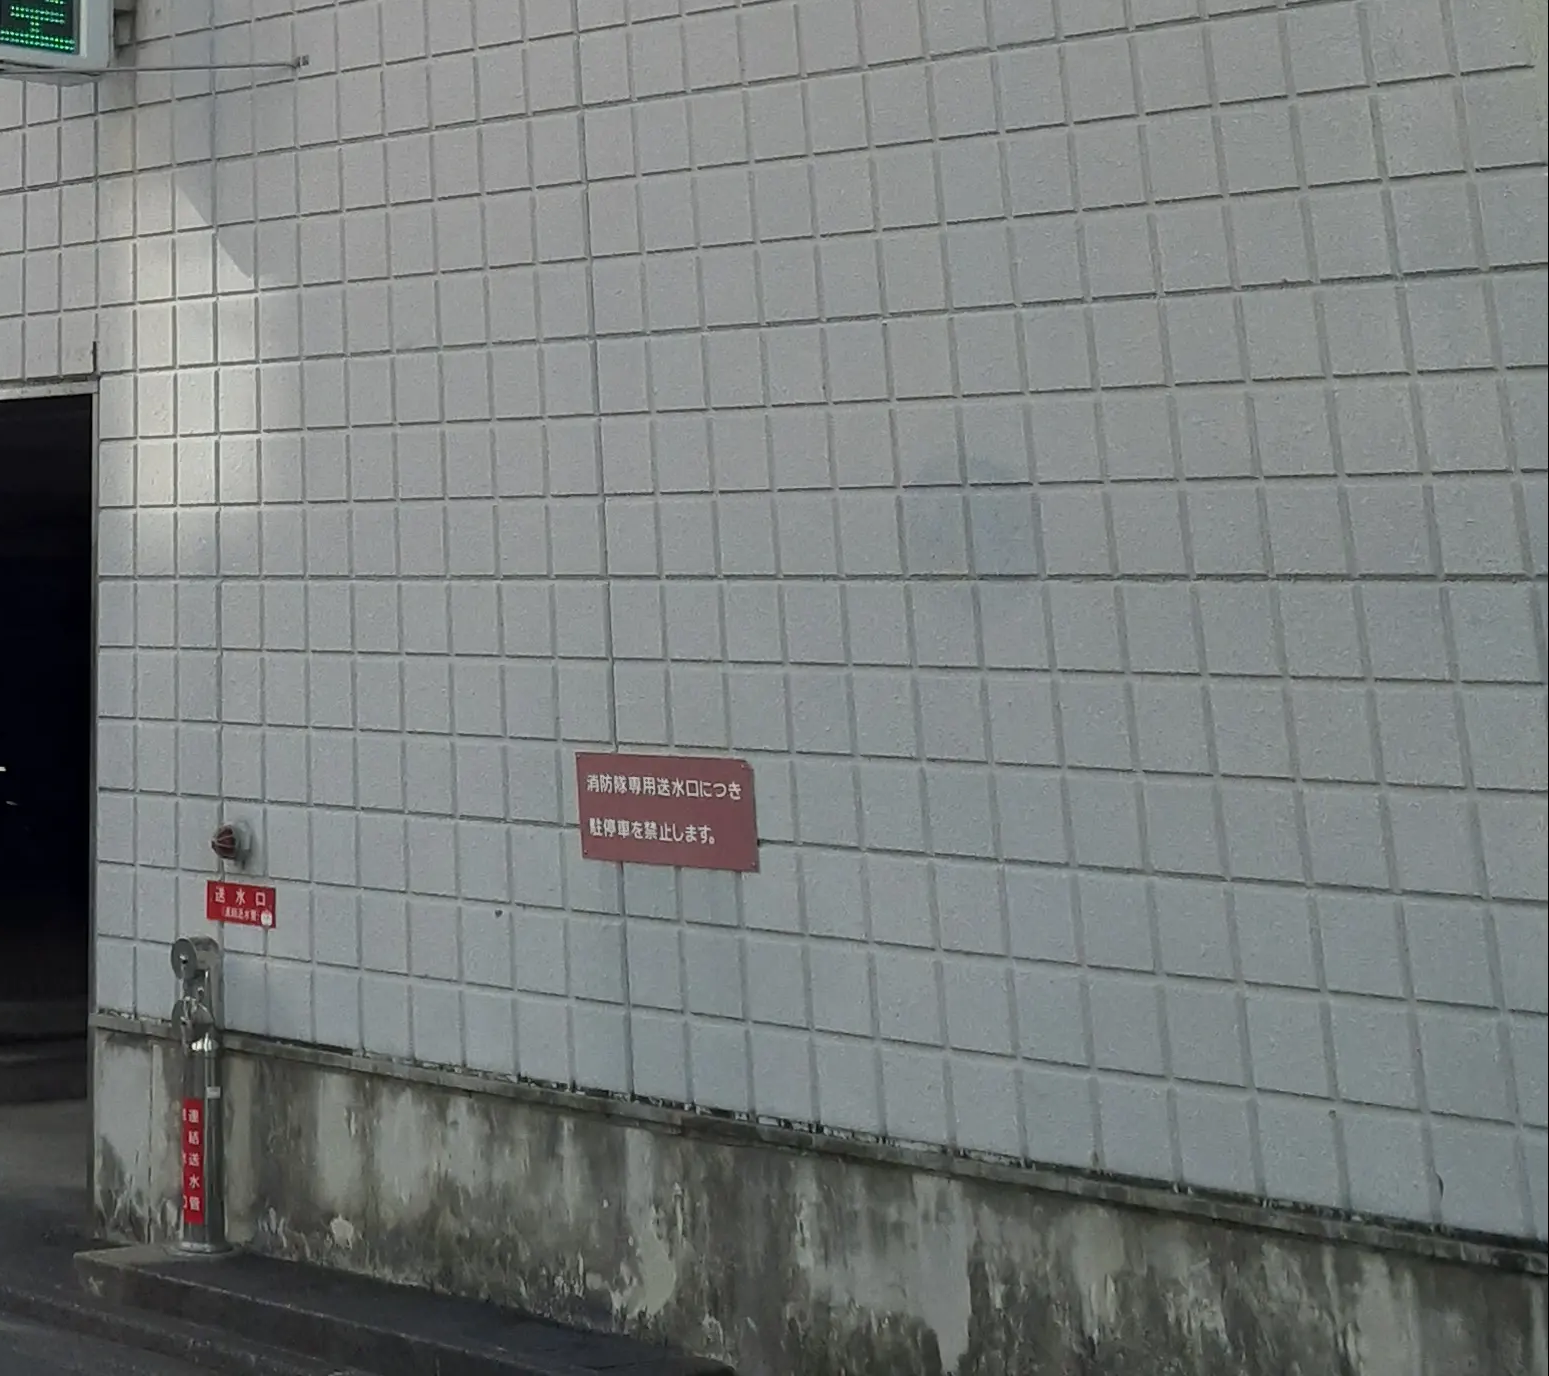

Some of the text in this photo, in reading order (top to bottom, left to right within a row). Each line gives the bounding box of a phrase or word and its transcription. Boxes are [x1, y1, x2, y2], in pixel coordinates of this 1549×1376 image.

[587, 775, 741, 800] 消防隊専用送水口につき
[589, 818, 715, 844] 駐停車を禁止します。
